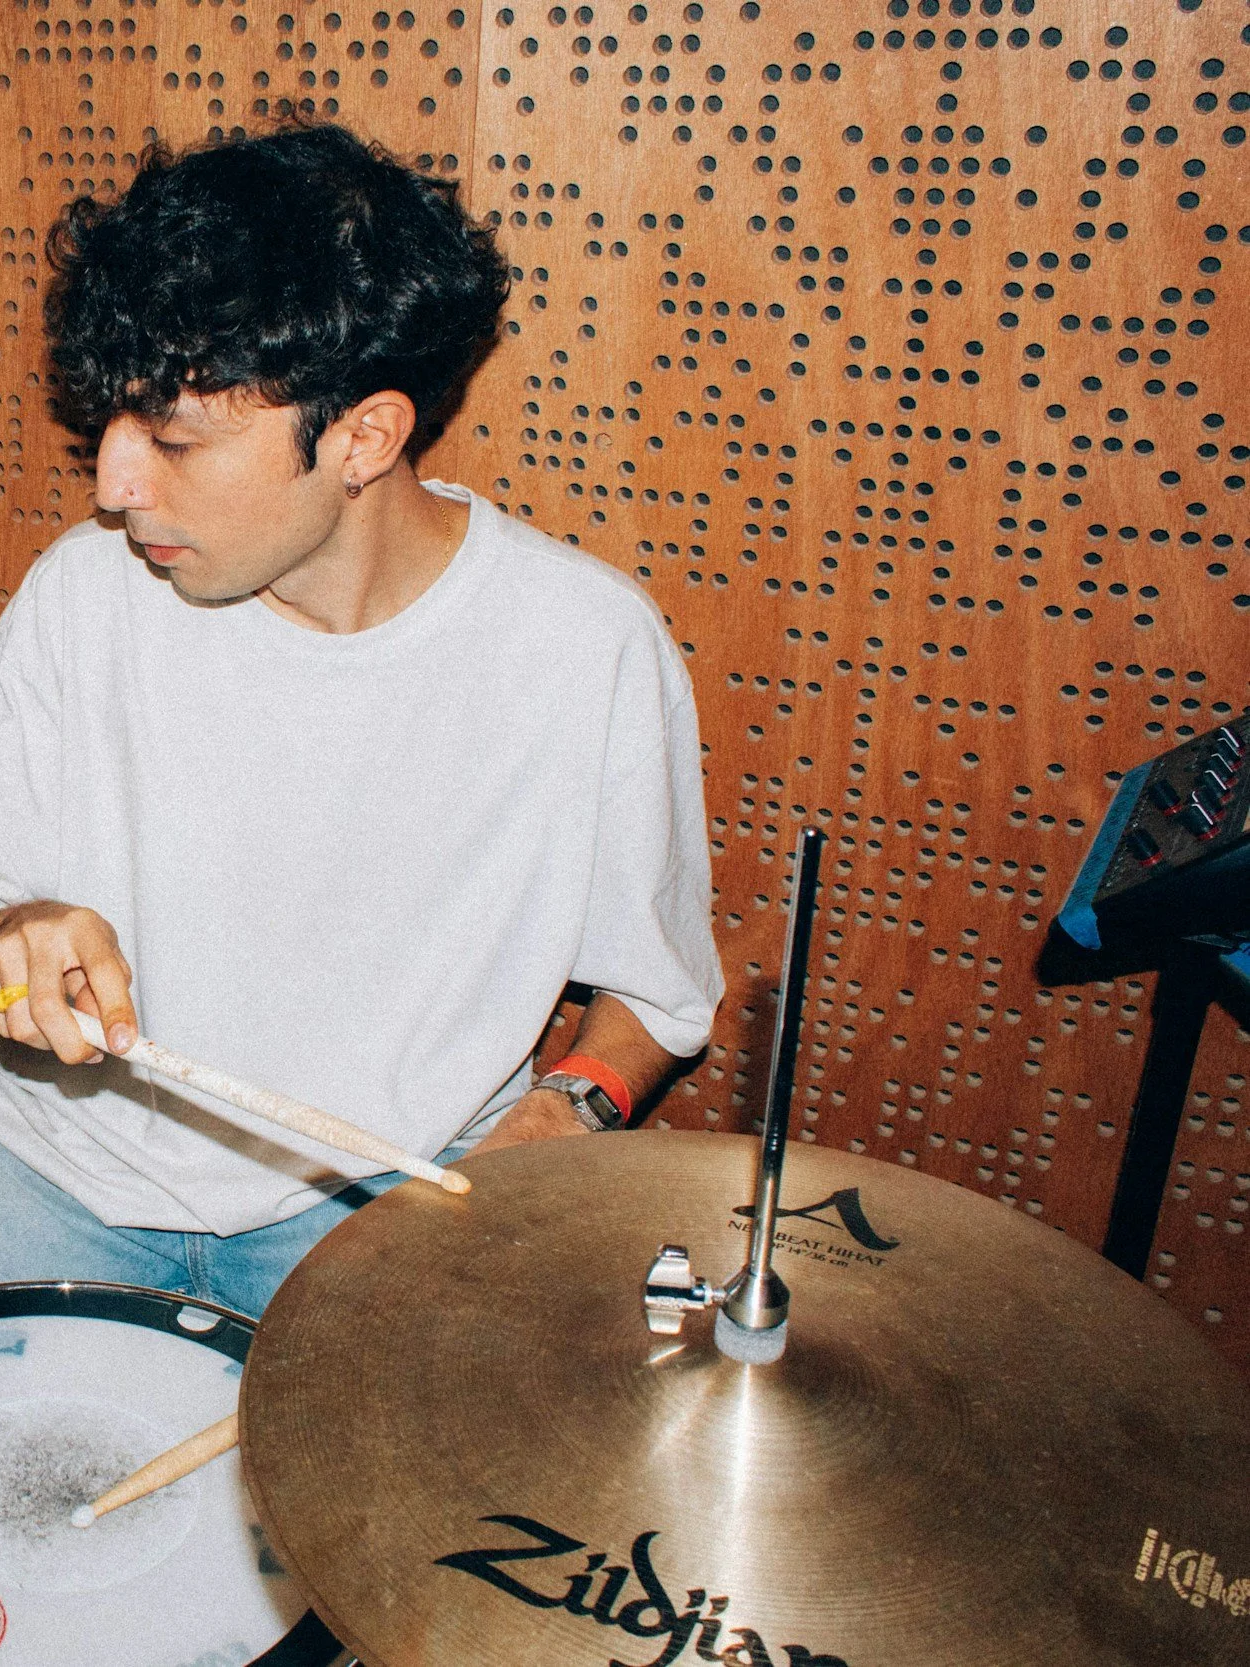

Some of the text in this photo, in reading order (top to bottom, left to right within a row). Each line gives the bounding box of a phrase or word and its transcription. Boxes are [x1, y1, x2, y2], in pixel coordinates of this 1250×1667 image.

[774, 1231, 823, 1250] BEAT
[828, 1245, 889, 1267] HIHAT
[828, 1258, 850, 1268] cm
